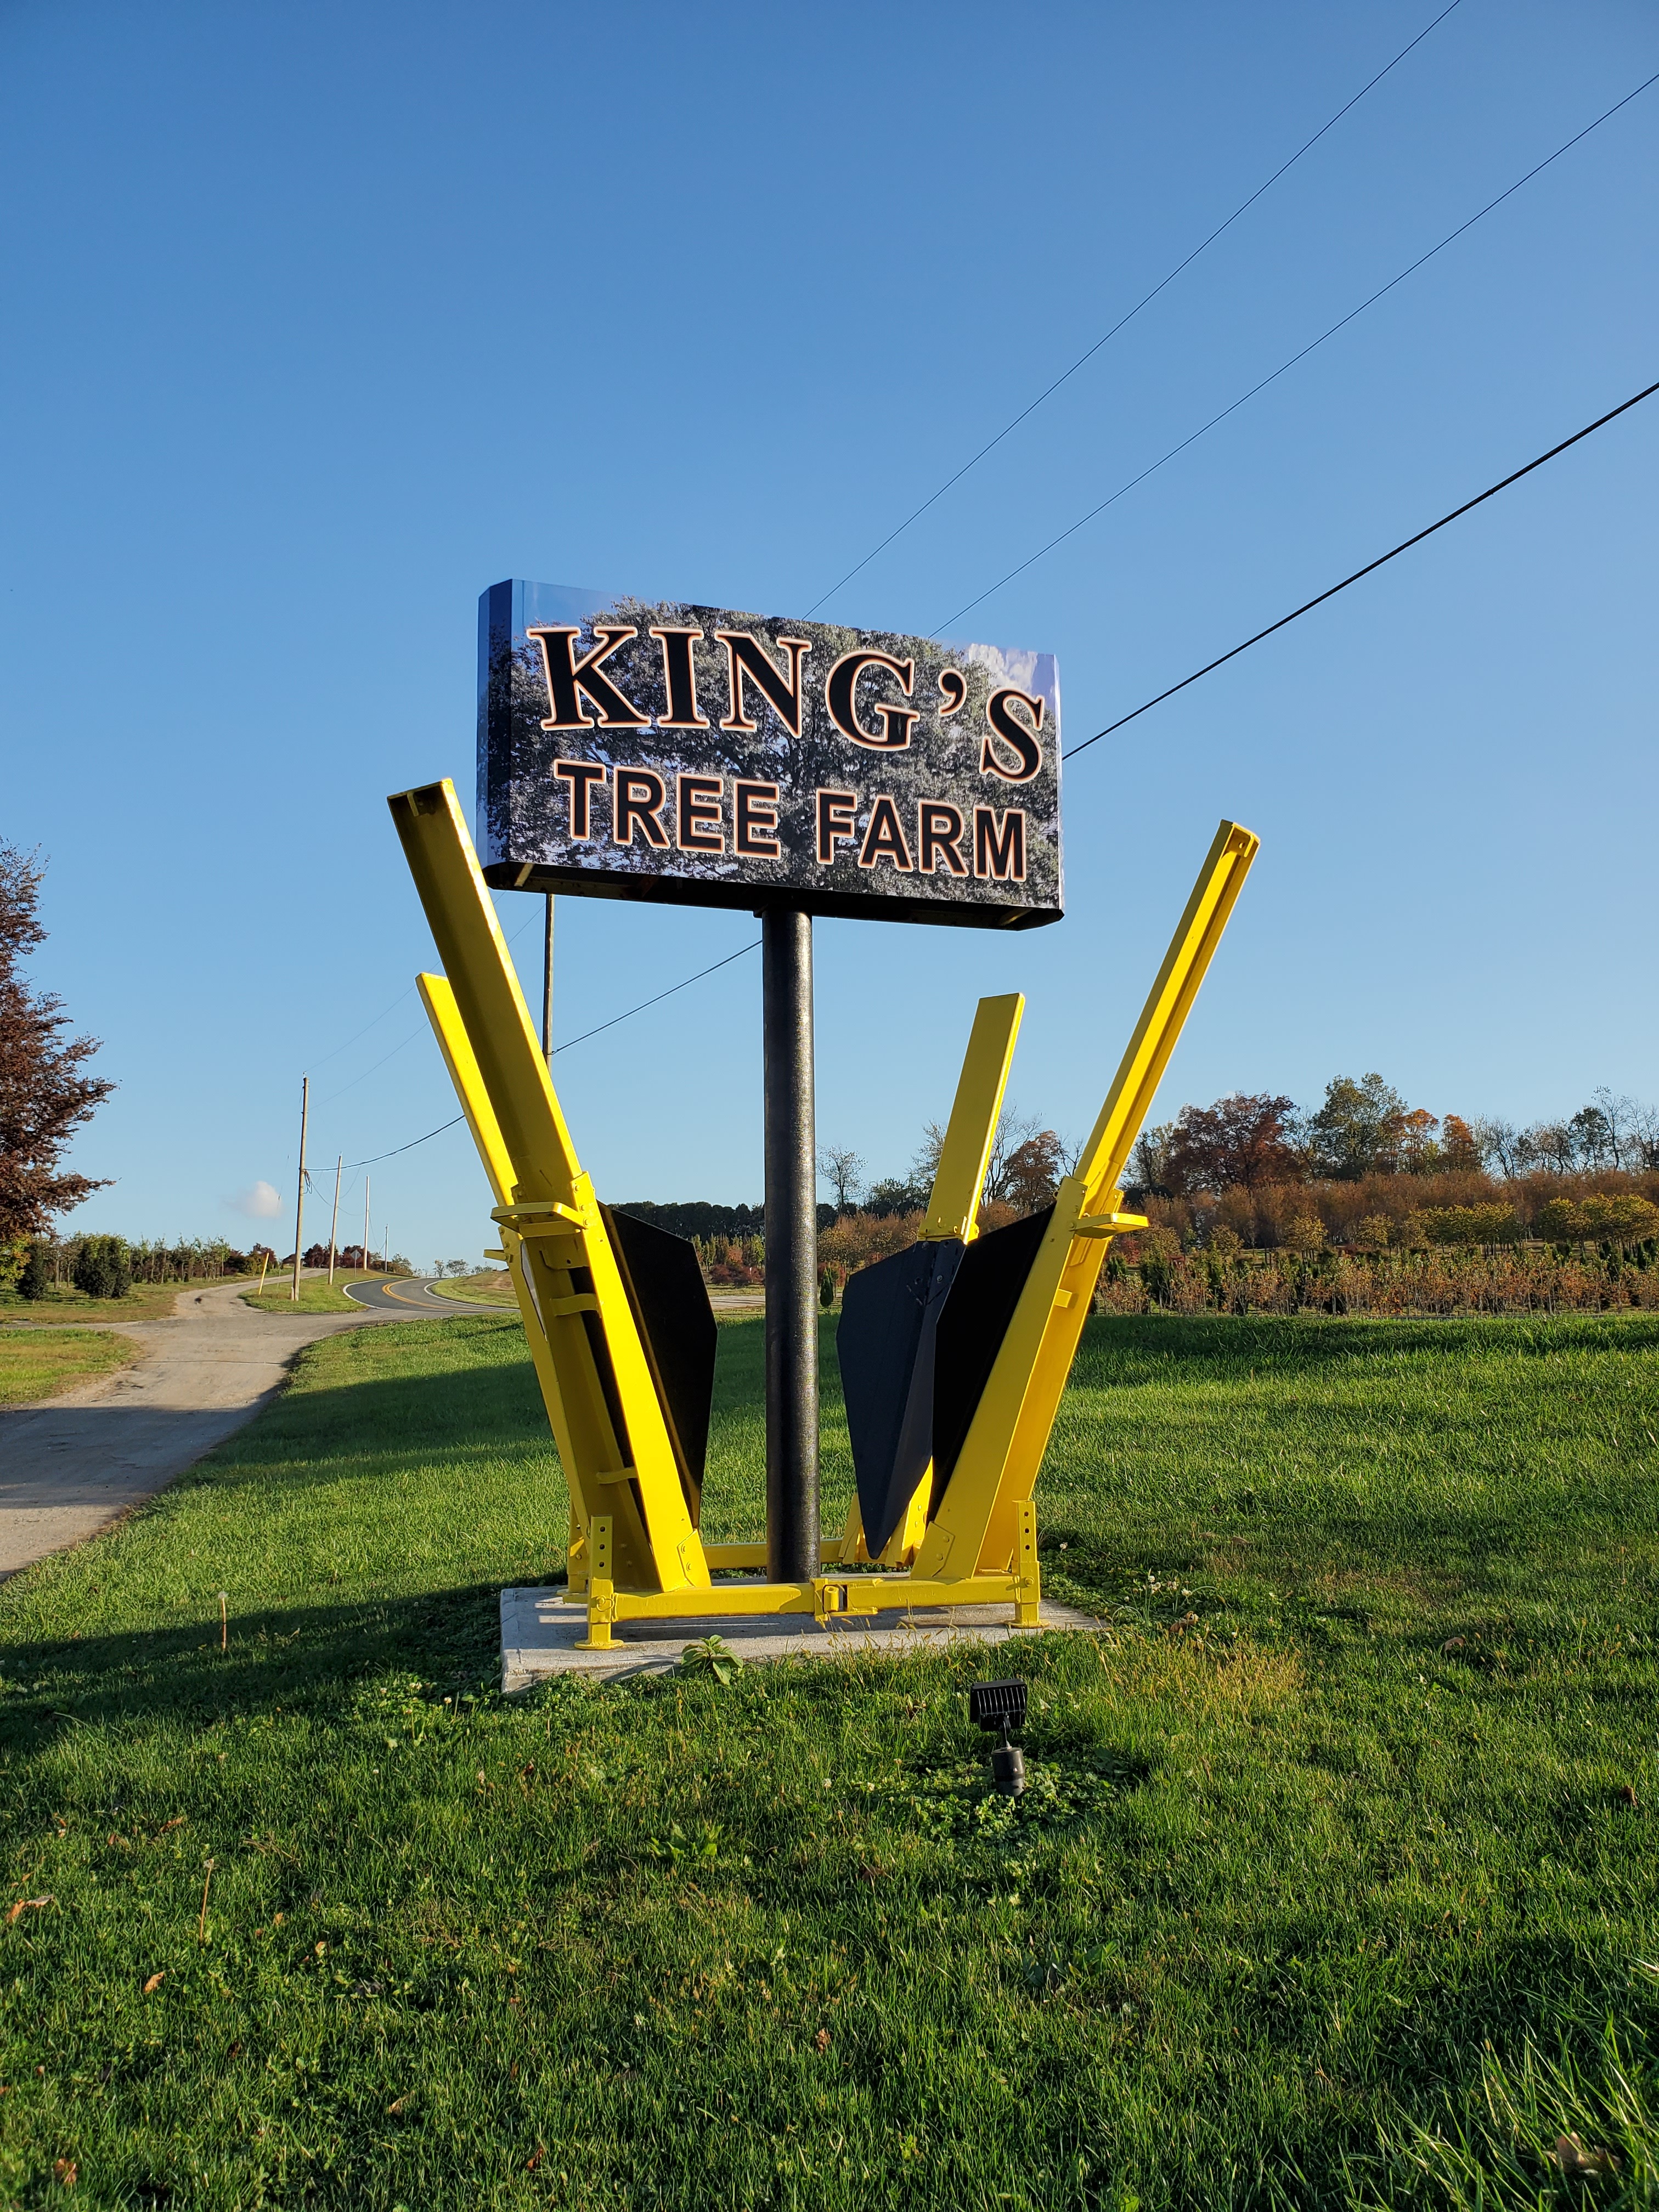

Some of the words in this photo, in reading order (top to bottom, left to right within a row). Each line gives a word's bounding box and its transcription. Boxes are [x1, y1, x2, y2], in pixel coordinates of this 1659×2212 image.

[526, 625, 1045, 784] KING'S
[553, 759, 782, 860] TREE
[815, 788, 1027, 883] FARM
